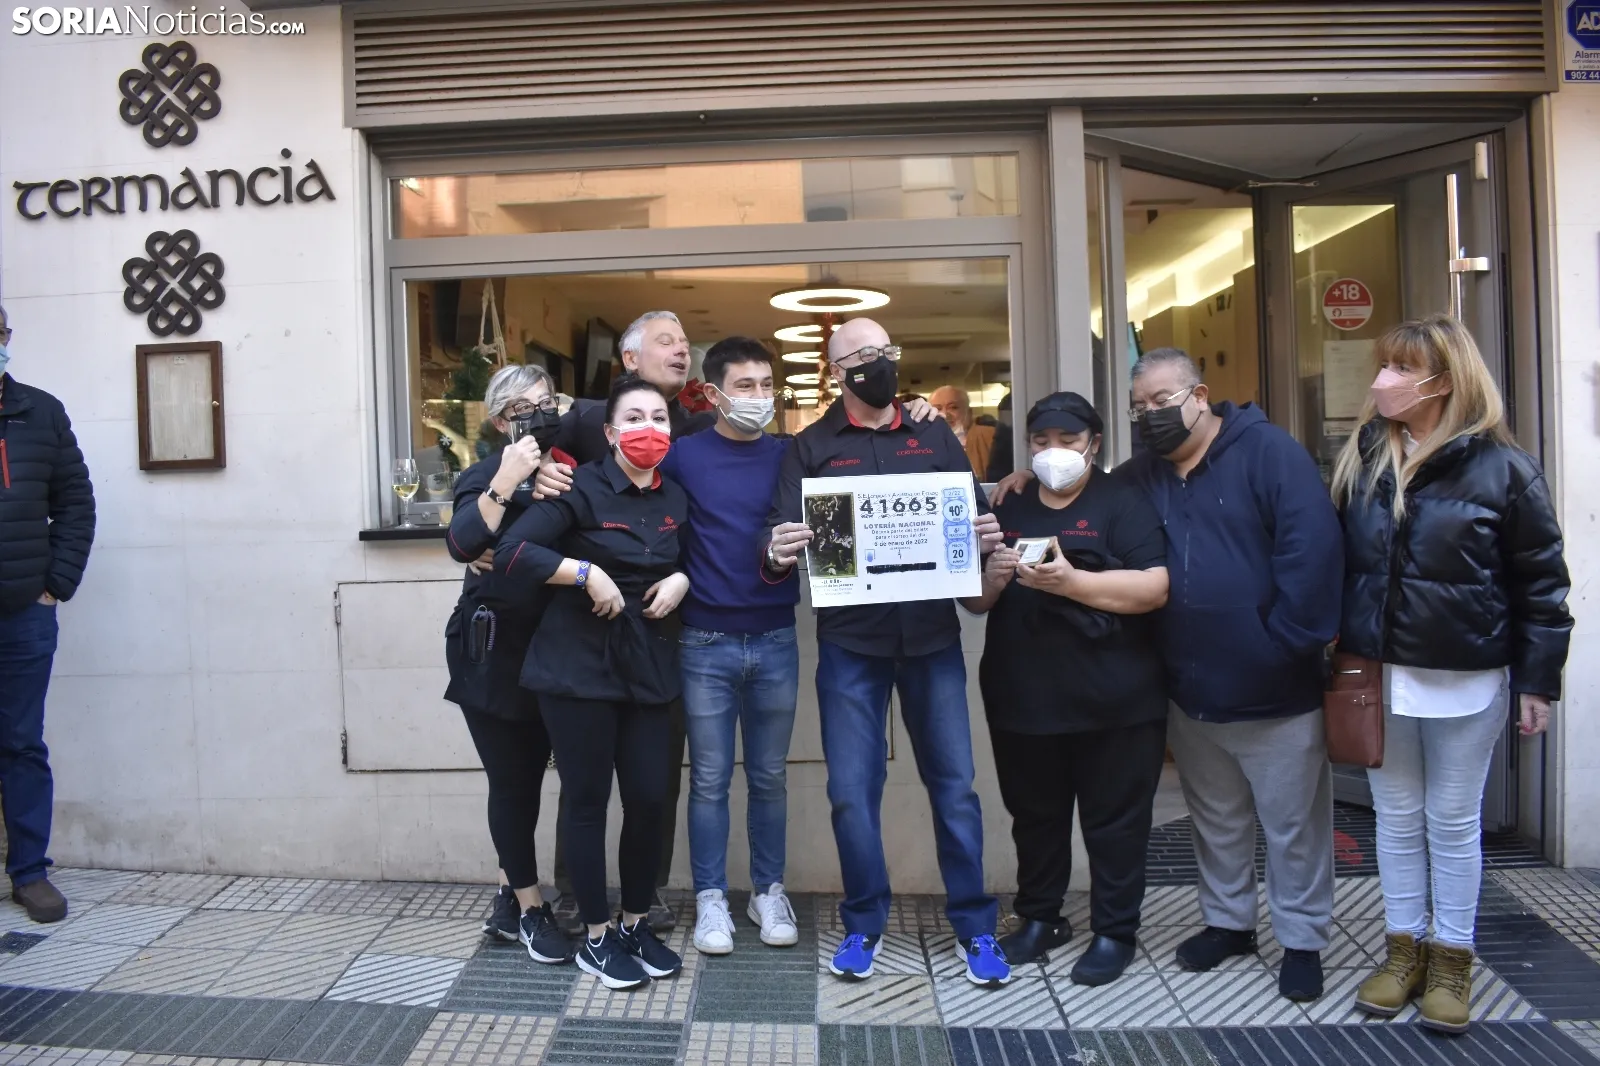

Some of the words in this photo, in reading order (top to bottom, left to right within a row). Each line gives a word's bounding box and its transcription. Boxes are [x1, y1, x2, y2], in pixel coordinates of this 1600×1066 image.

[1571, 72, 1587, 80] 902
[1589, 71, 1600, 80] 44
[1332, 283, 1360, 301] +18
[859, 496, 937, 515] 41665
[863, 521, 896, 530] LOTERÍA
[898, 520, 936, 528] NACIONAL
[952, 548, 964, 559] 20
